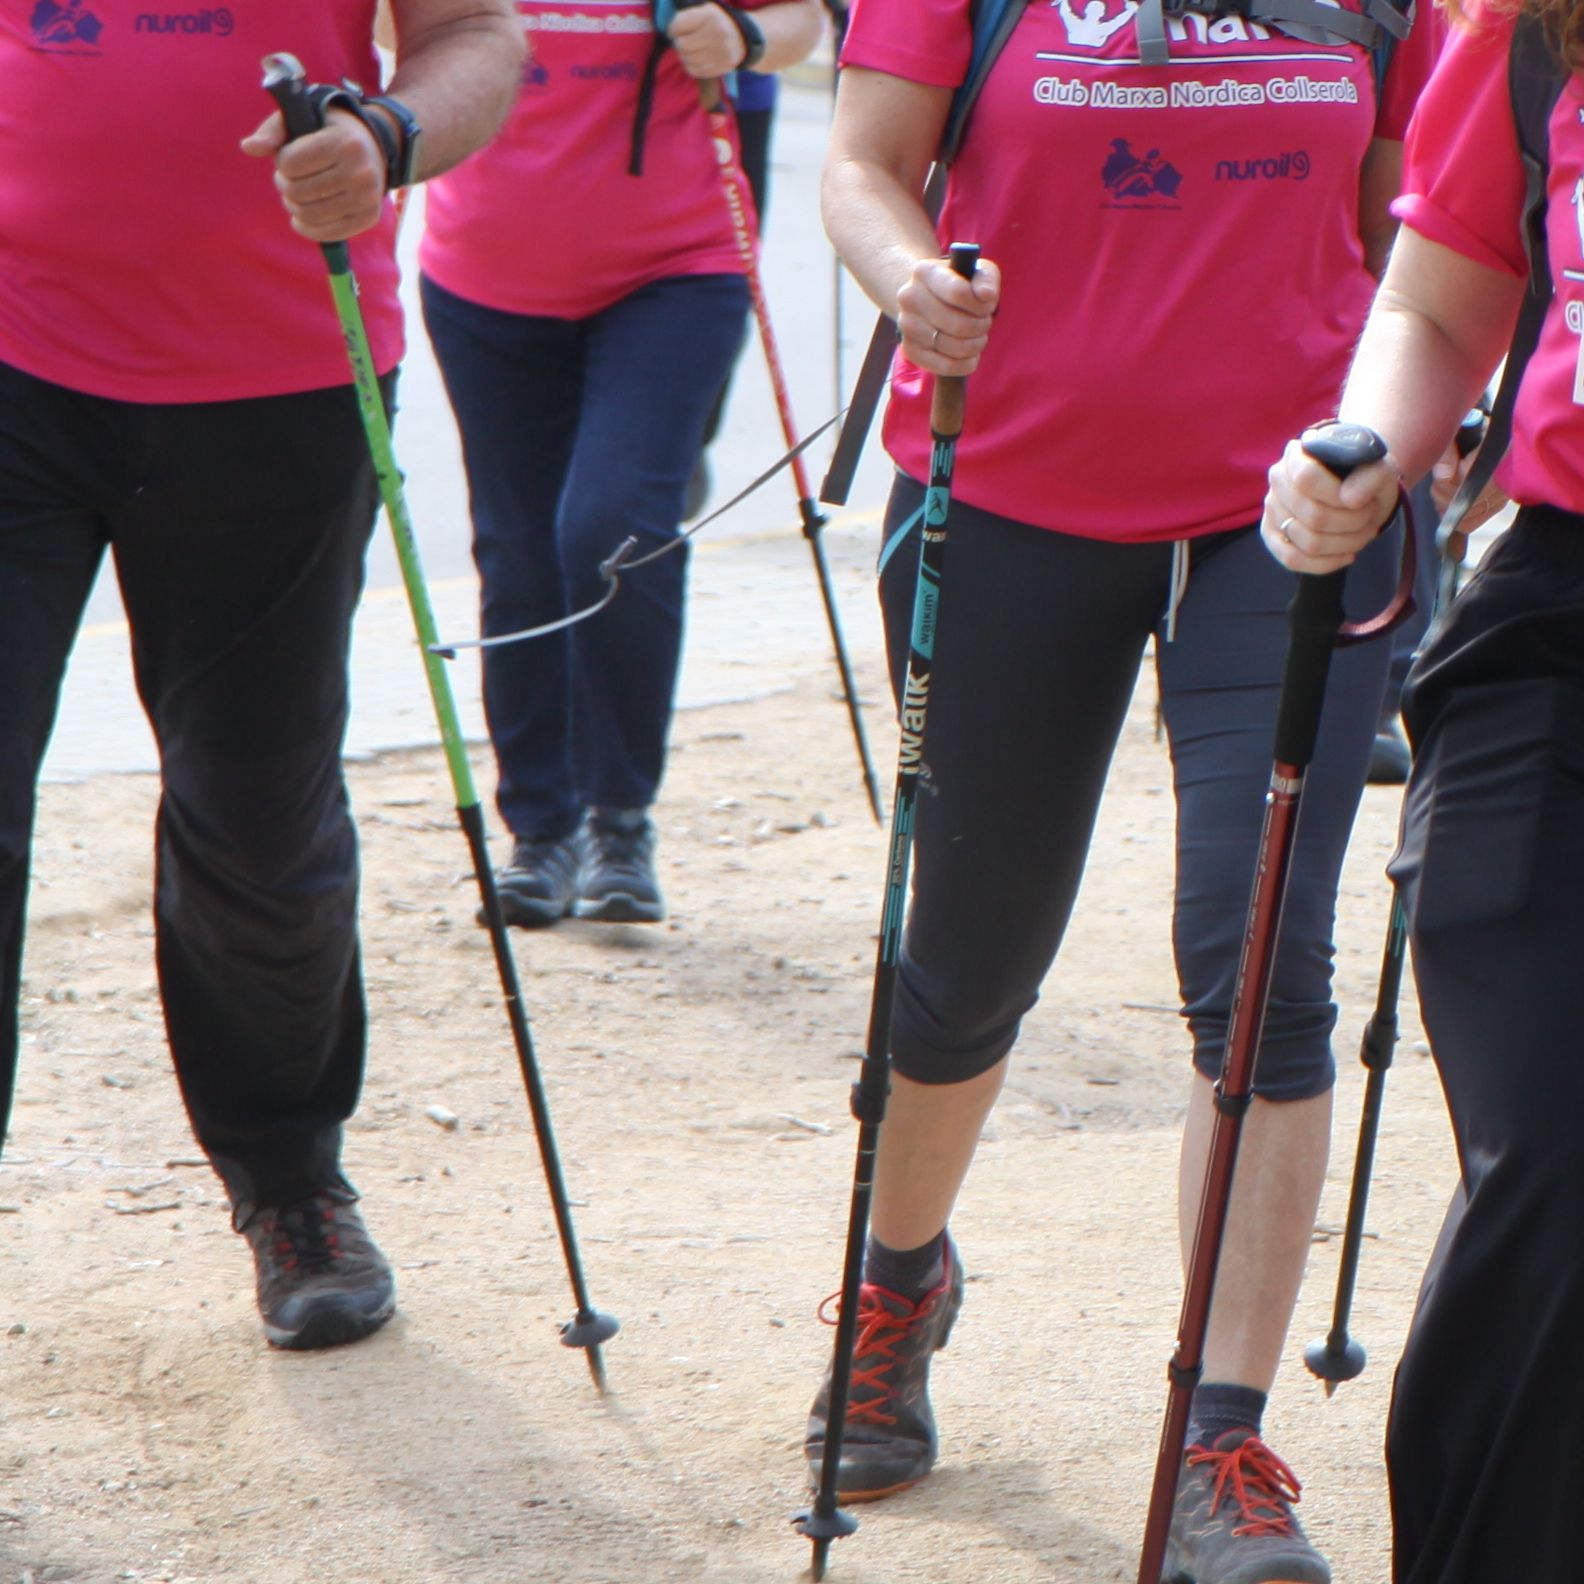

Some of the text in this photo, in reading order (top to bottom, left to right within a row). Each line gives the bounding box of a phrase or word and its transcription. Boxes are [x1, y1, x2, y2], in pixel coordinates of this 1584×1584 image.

[1034, 75, 1358, 108] Club Marxa Nòrdica Collserola
